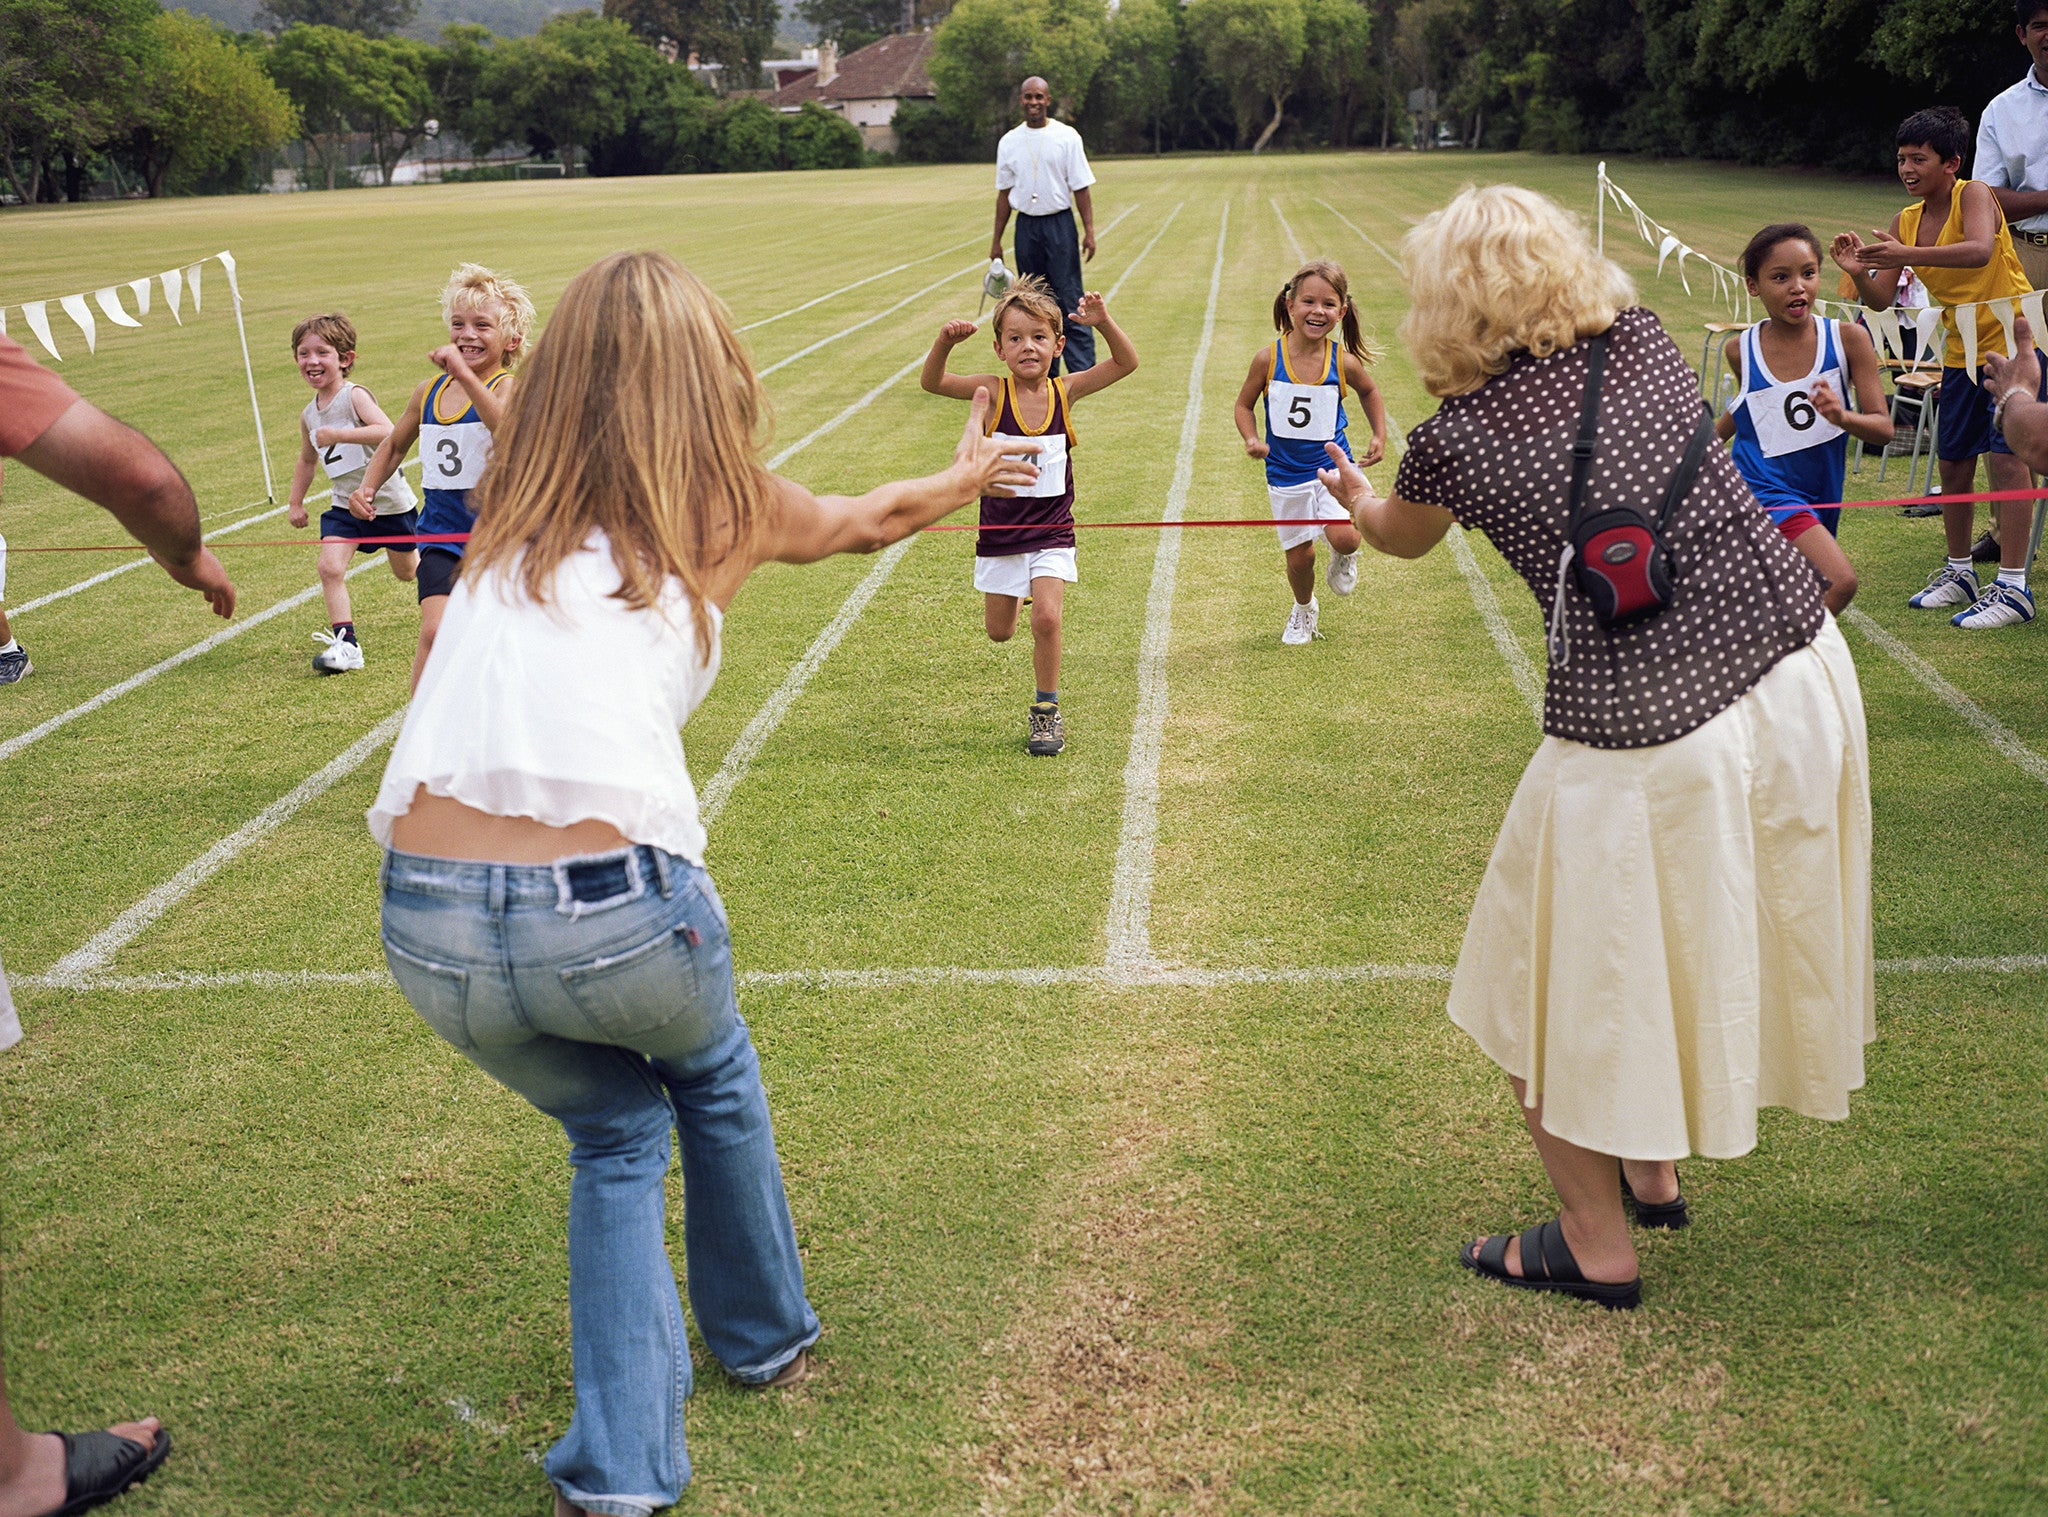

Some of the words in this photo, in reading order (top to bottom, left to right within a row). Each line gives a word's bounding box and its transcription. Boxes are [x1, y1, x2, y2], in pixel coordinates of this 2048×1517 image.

[1288, 396, 1311, 428] 5
[1784, 391, 1816, 431] 6
[437, 439, 462, 476] 3
